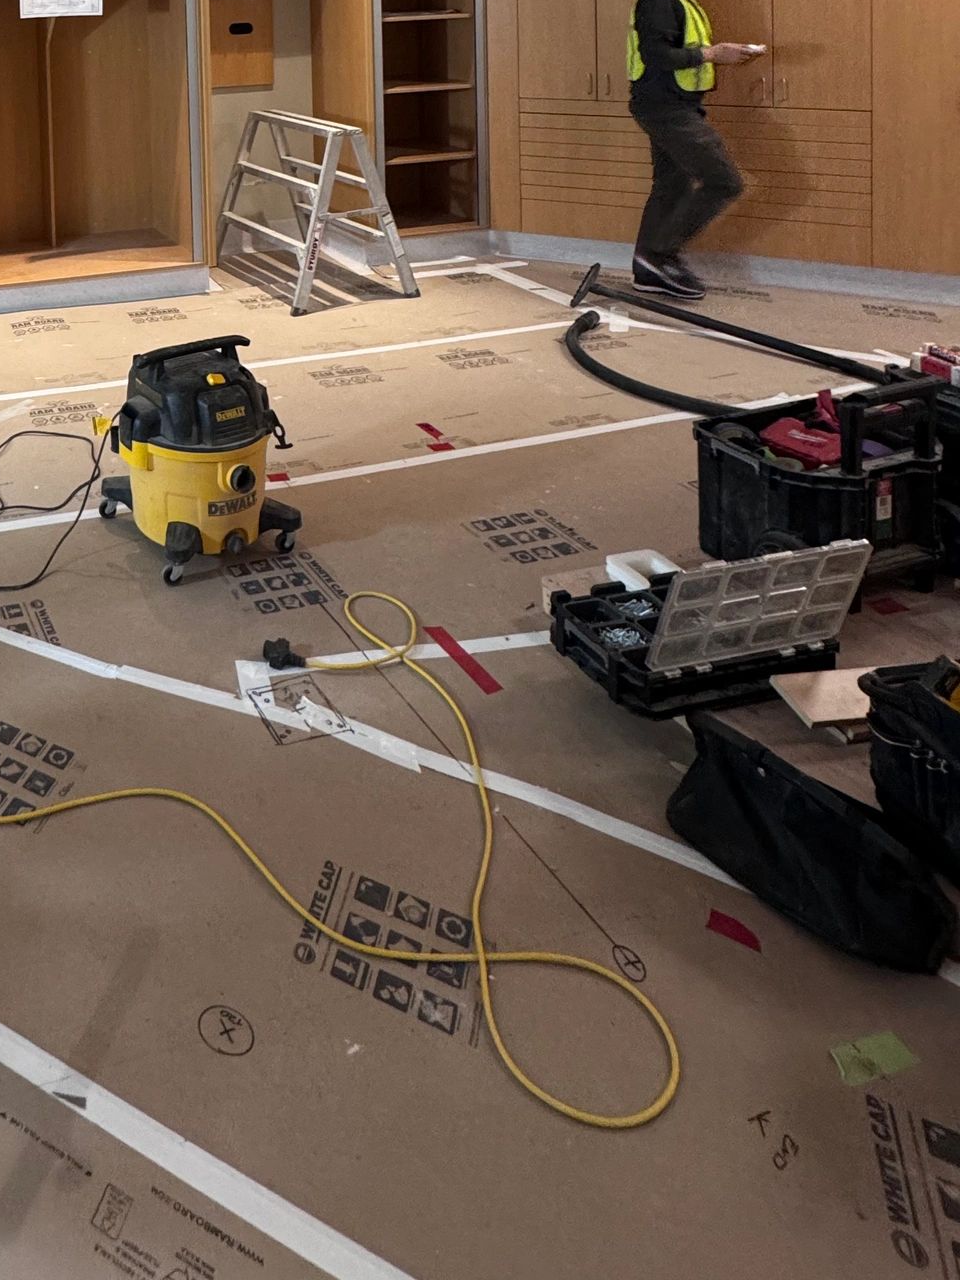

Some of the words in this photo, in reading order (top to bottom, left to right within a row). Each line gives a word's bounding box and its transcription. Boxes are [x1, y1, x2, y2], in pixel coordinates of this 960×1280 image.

[307, 237, 319, 271] STURDY
[11, 321, 32, 329] RAM
[34, 317, 65, 325] BOARD
[29, 407, 54, 418] RAM
[57, 403, 96, 413] BOARD
[216, 405, 246, 422] DEWALT
[208, 490, 258, 517] DEWALT
[310, 560, 337, 585] WHITE
[331, 584, 349, 600] CAP
[38, 608, 57, 636] WHITE
[300, 890, 327, 940] WITE
[318, 860, 337, 891] CAP
[865, 1093, 892, 1142] CAP
[874, 1142, 910, 1225] WHITE
